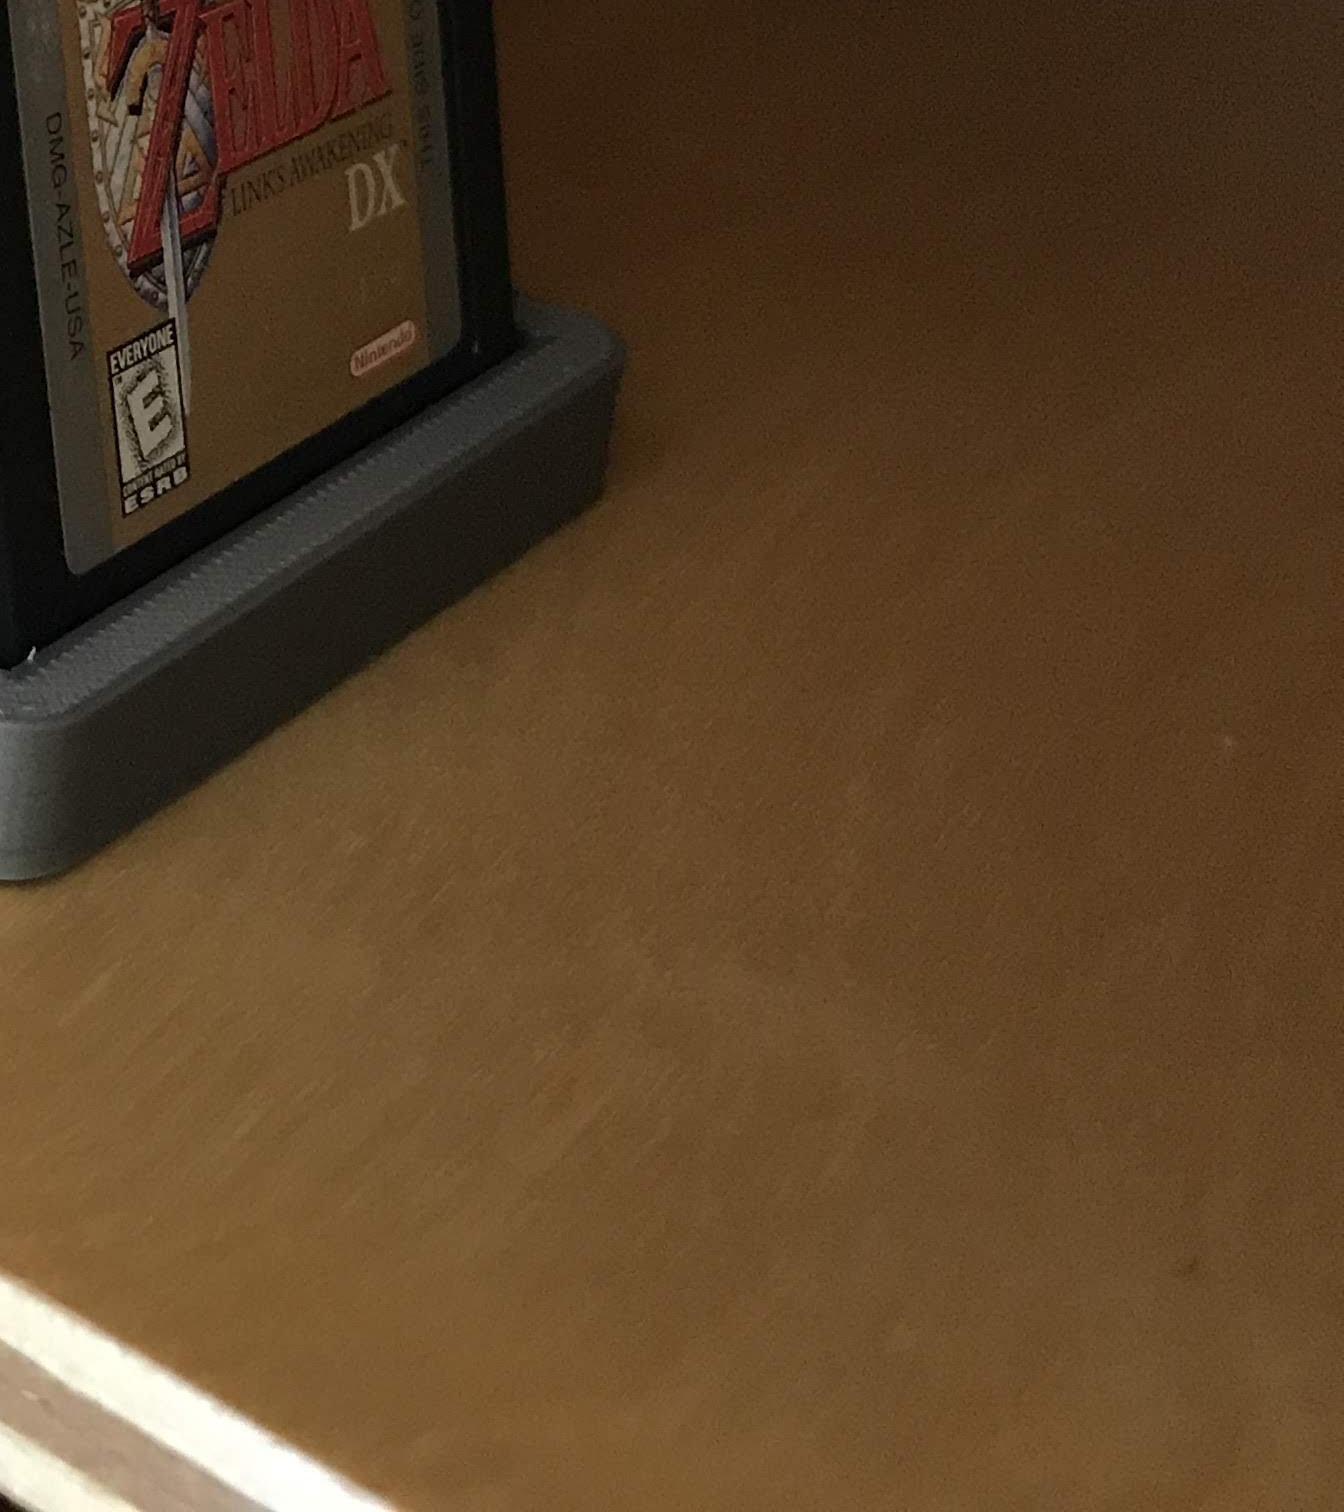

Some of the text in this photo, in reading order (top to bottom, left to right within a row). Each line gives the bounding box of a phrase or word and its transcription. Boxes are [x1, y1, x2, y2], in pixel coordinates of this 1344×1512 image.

[288, 111, 395, 186] AWAKENING
[344, 143, 408, 232] DX
[44, 111, 86, 363] DMG-AZLE-USA
[110, 323, 176, 375] EVERYONE
[354, 322, 413, 371] Nintendo
[126, 369, 174, 460] E
[124, 465, 189, 516] ESRB
